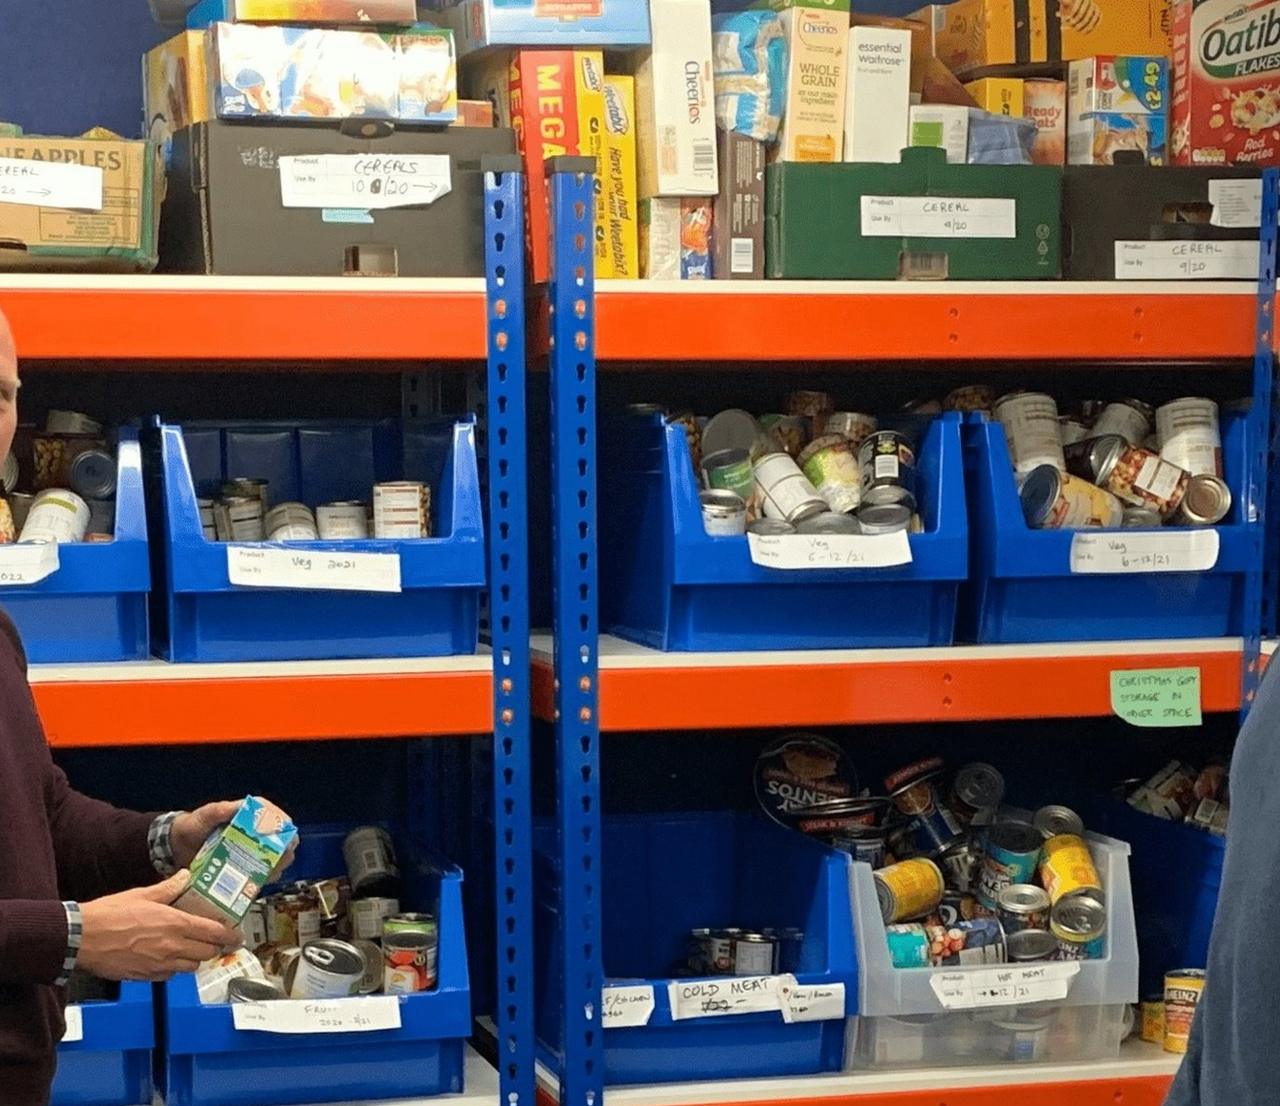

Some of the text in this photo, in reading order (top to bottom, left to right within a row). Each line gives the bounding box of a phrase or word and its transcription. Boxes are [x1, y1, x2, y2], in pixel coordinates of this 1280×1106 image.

[858, 43, 903, 53] essential
[858, 54, 902, 66] Waitrose
[799, 63, 841, 78] WHOLE
[801, 75, 837, 88] GRAIN
[684, 60, 702, 126] Cheerios
[536, 63, 569, 160] MEGA
[1025, 106, 1062, 121] Ready
[1244, 136, 1266, 151] Red
[353, 159, 419, 177] CEREALS
[609, 147, 632, 221] Have you had
[922, 202, 970, 213] CEREAL
[1171, 243, 1223, 256] CEREAL
[1178, 259, 1207, 275] 9/20
[808, 539, 830, 551] Veg
[1109, 542, 1127, 554] Veg
[291, 556, 357, 571] Veg 2021
[682, 977, 769, 1000] COLD MEAT
